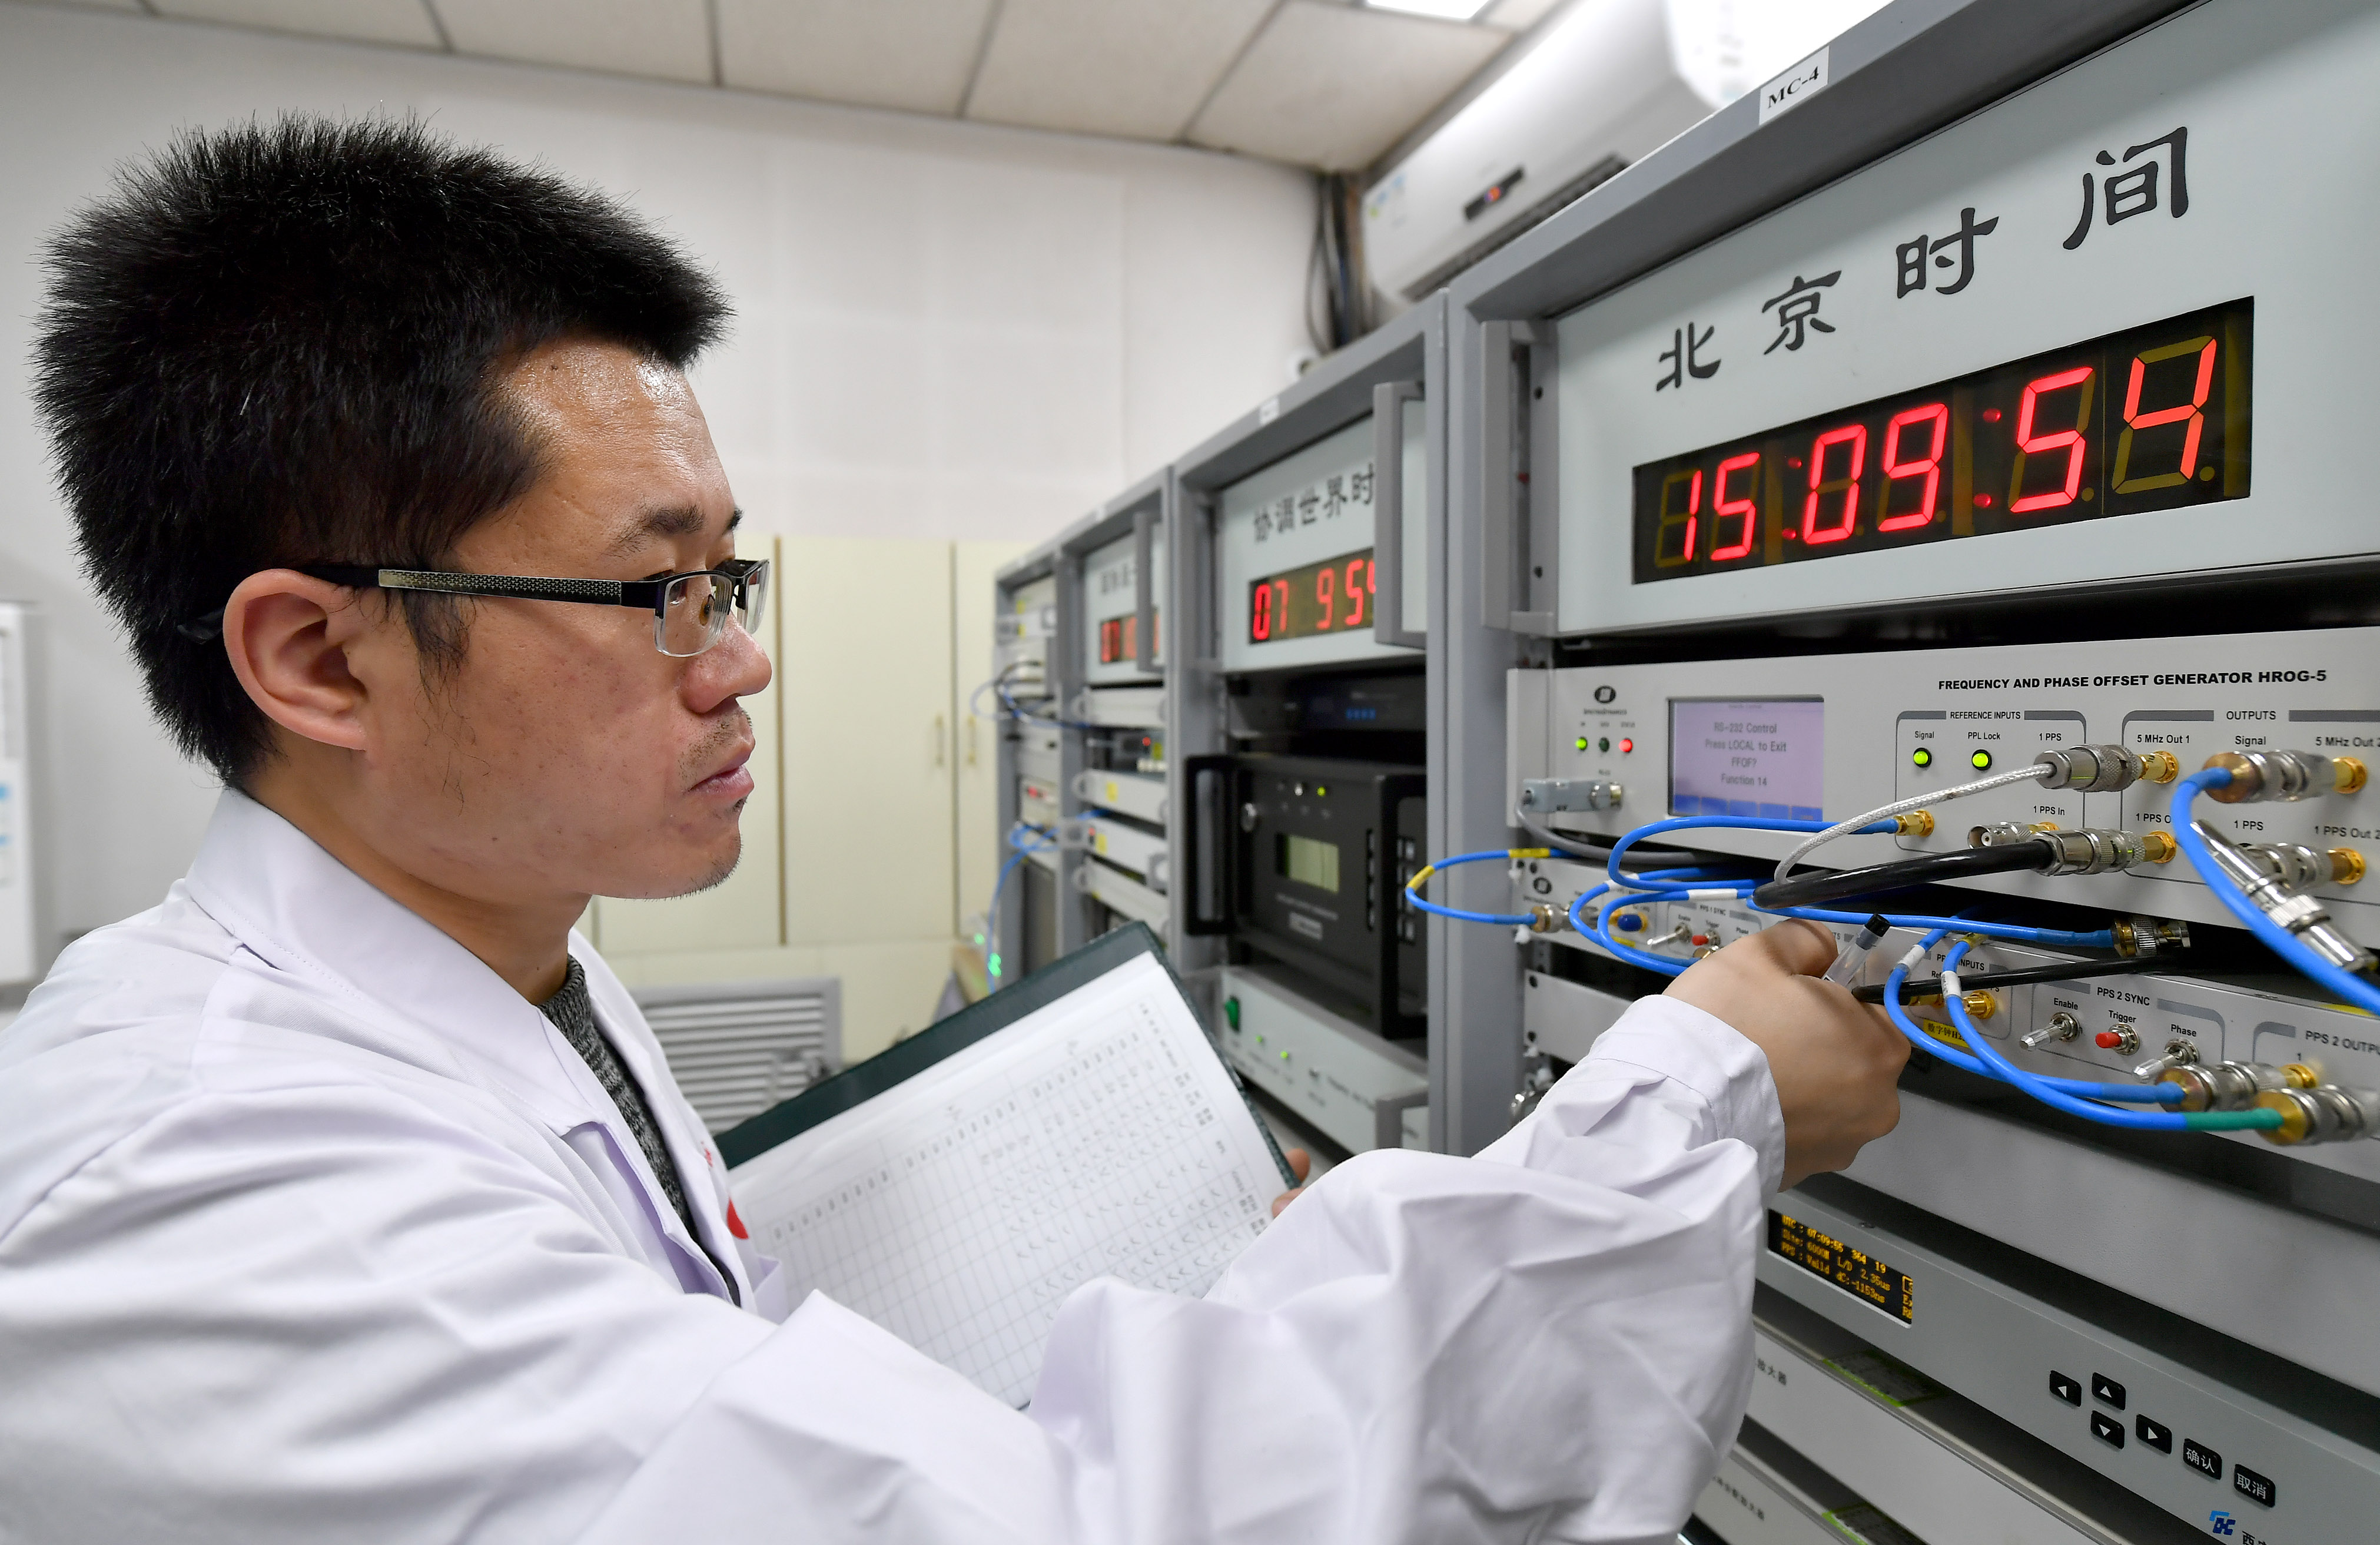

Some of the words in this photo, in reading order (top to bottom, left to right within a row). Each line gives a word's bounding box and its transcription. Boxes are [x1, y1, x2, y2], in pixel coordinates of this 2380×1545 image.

[1768, 66, 1819, 109] MC-4
[1656, 126, 2189, 392] 北京时间
[1938, 678, 2010, 690] FREQUENCY
[2013, 678, 2040, 689] AND
[2044, 677, 2089, 688] PHASE
[2093, 675, 2149, 687] OFFSET
[2153, 672, 2253, 685] GENERATOR
[2258, 670, 2327, 683] HROG-5
[1950, 711, 1993, 720] REFERENCE
[1994, 711, 2021, 720] INPUTS
[2226, 711, 2276, 720] OUTPUTS
[1714, 722, 1744, 733] RS-232
[1746, 722, 1777, 734] Control
[1914, 731, 1934, 740] Signal
[2046, 733, 2062, 741] PPS
[2137, 734, 2142, 743] 5
[2145, 734, 2163, 744] MHz
[2166, 734, 2183, 744] Out
[2186, 735, 2190, 743] 1
[2235, 735, 2266, 747] Signal
[1728, 740, 1755, 751] LOCAL
[1758, 741, 1768, 751] to
[1771, 741, 1787, 752] Exit
[2315, 737, 2322, 746] 5
[2325, 737, 2349, 747] MHz
[2352, 737, 2374, 747] Out
[1721, 773, 1755, 785] Function
[2033, 805, 2037, 814] 1
[2040, 806, 2056, 815] PPS
[2058, 807, 2065, 815] In
[2136, 813, 2140, 821] 1
[2143, 813, 2162, 823] PPS
[2234, 820, 2239, 829] 1
[2242, 821, 2264, 831] PPS
[2314, 825, 2319, 835] 1
[2323, 826, 2347, 837] PPS
[2351, 828, 2371, 838] Out
[1937, 953, 1946, 962] PP
[2097, 986, 2115, 999] PPS
[2117, 992, 2122, 1000] 2
[2125, 992, 2150, 1006] SYNC
[2053, 997, 2079, 1010] Enable
[2108, 1010, 2137, 1023] Trigger
[2170, 1023, 2197, 1037] Phase
[2305, 1030, 2329, 1044] PPS
[2332, 1036, 2339, 1046] 2
[2186, 1447, 2215, 1473] 确认
[2236, 1473, 2266, 1500] 取消
